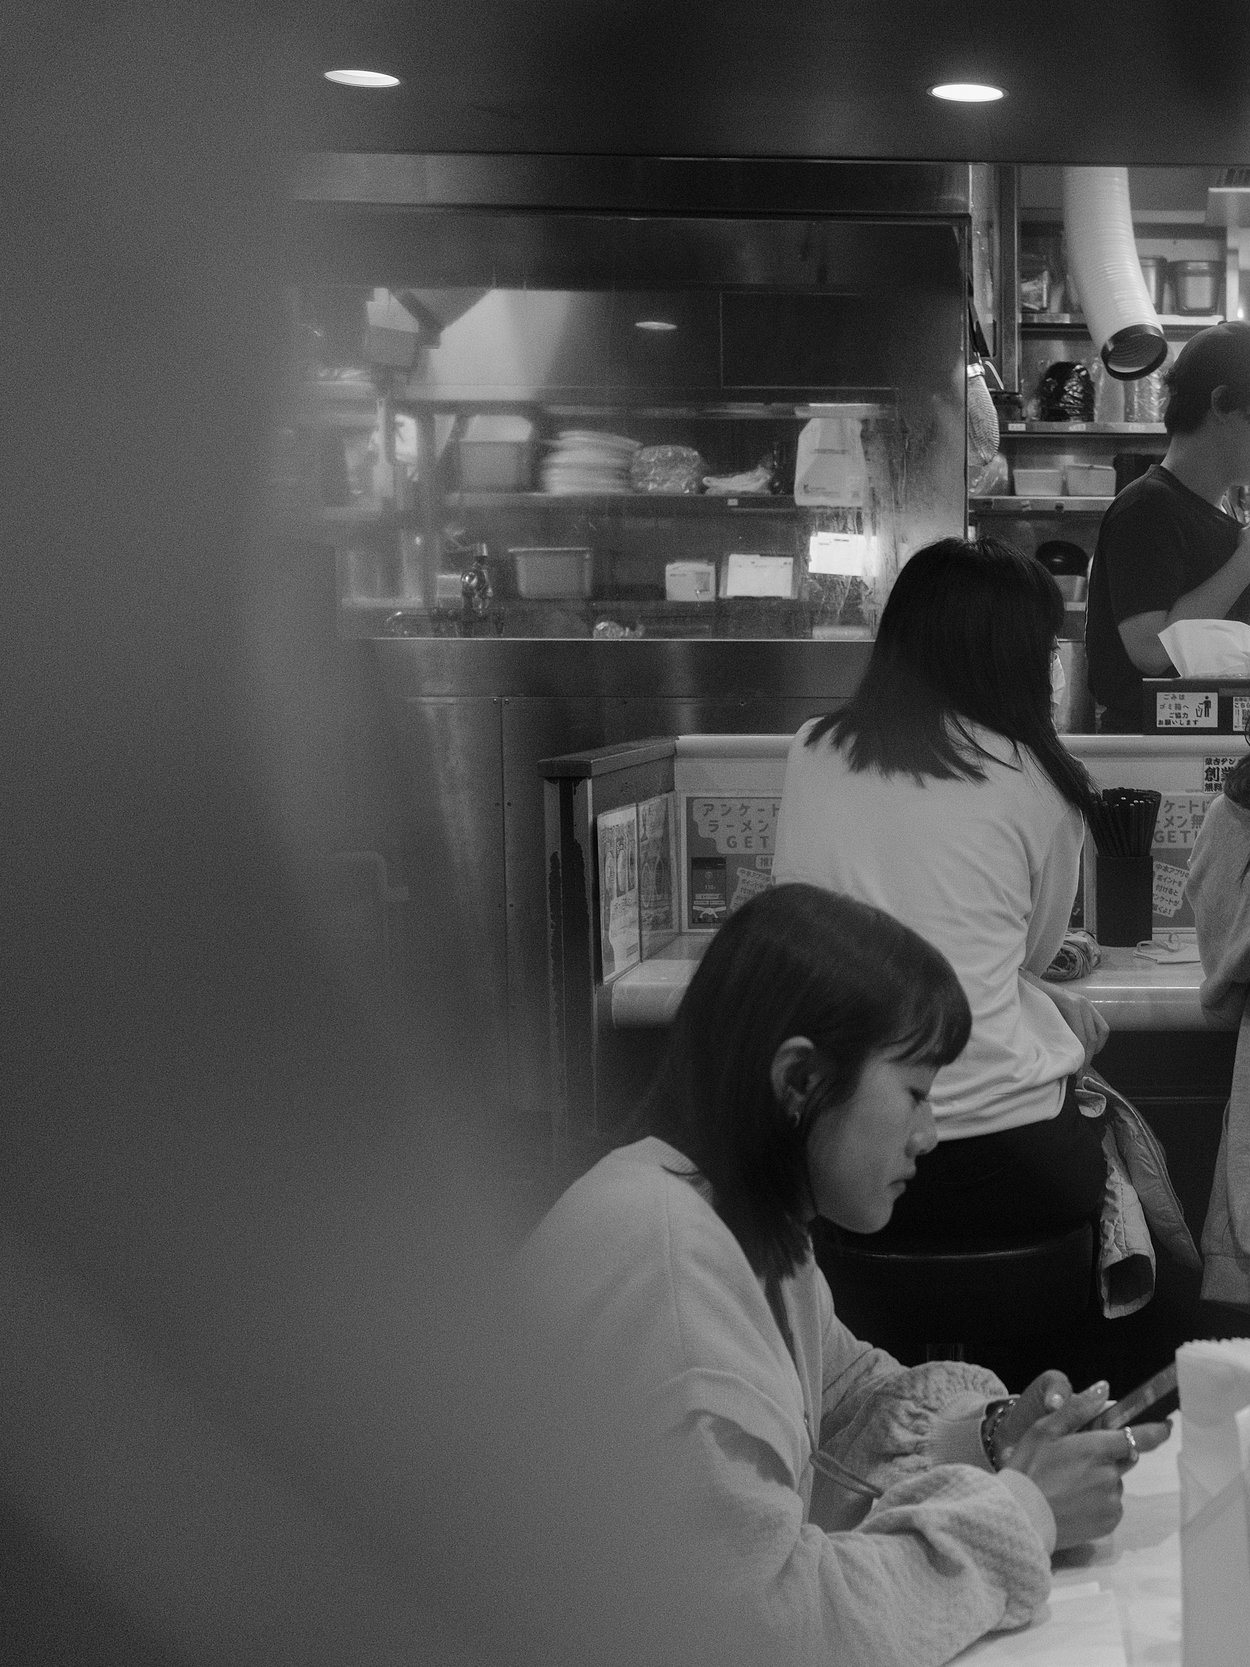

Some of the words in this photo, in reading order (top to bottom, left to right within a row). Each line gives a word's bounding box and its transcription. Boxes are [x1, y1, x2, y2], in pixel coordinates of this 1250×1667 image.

[703, 803, 780, 817] アンケート
[708, 820, 769, 833] ラーメン
[726, 836, 769, 849] GET
[1153, 893, 1180, 907] ンケートが
